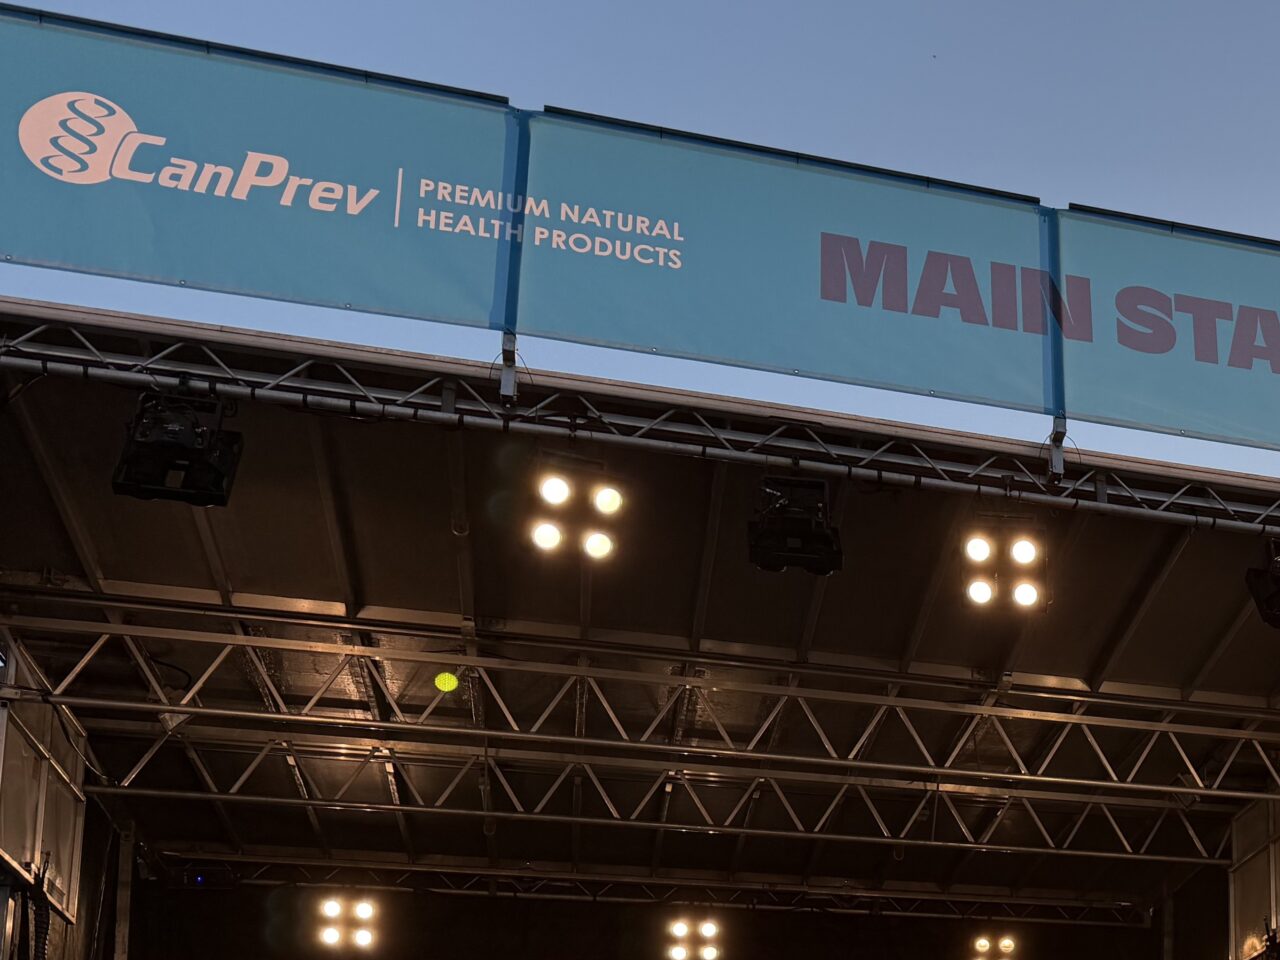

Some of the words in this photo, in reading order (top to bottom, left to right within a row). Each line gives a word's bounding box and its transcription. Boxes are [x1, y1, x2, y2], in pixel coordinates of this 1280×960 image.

[109, 129, 380, 218] CanPrev
[418, 178, 551, 220] PREMIUM
[559, 202, 685, 243] NATURAL
[415, 207, 523, 244] HEALTH
[533, 226, 683, 270] PRODUCTS
[820, 231, 1094, 343] MAIN
